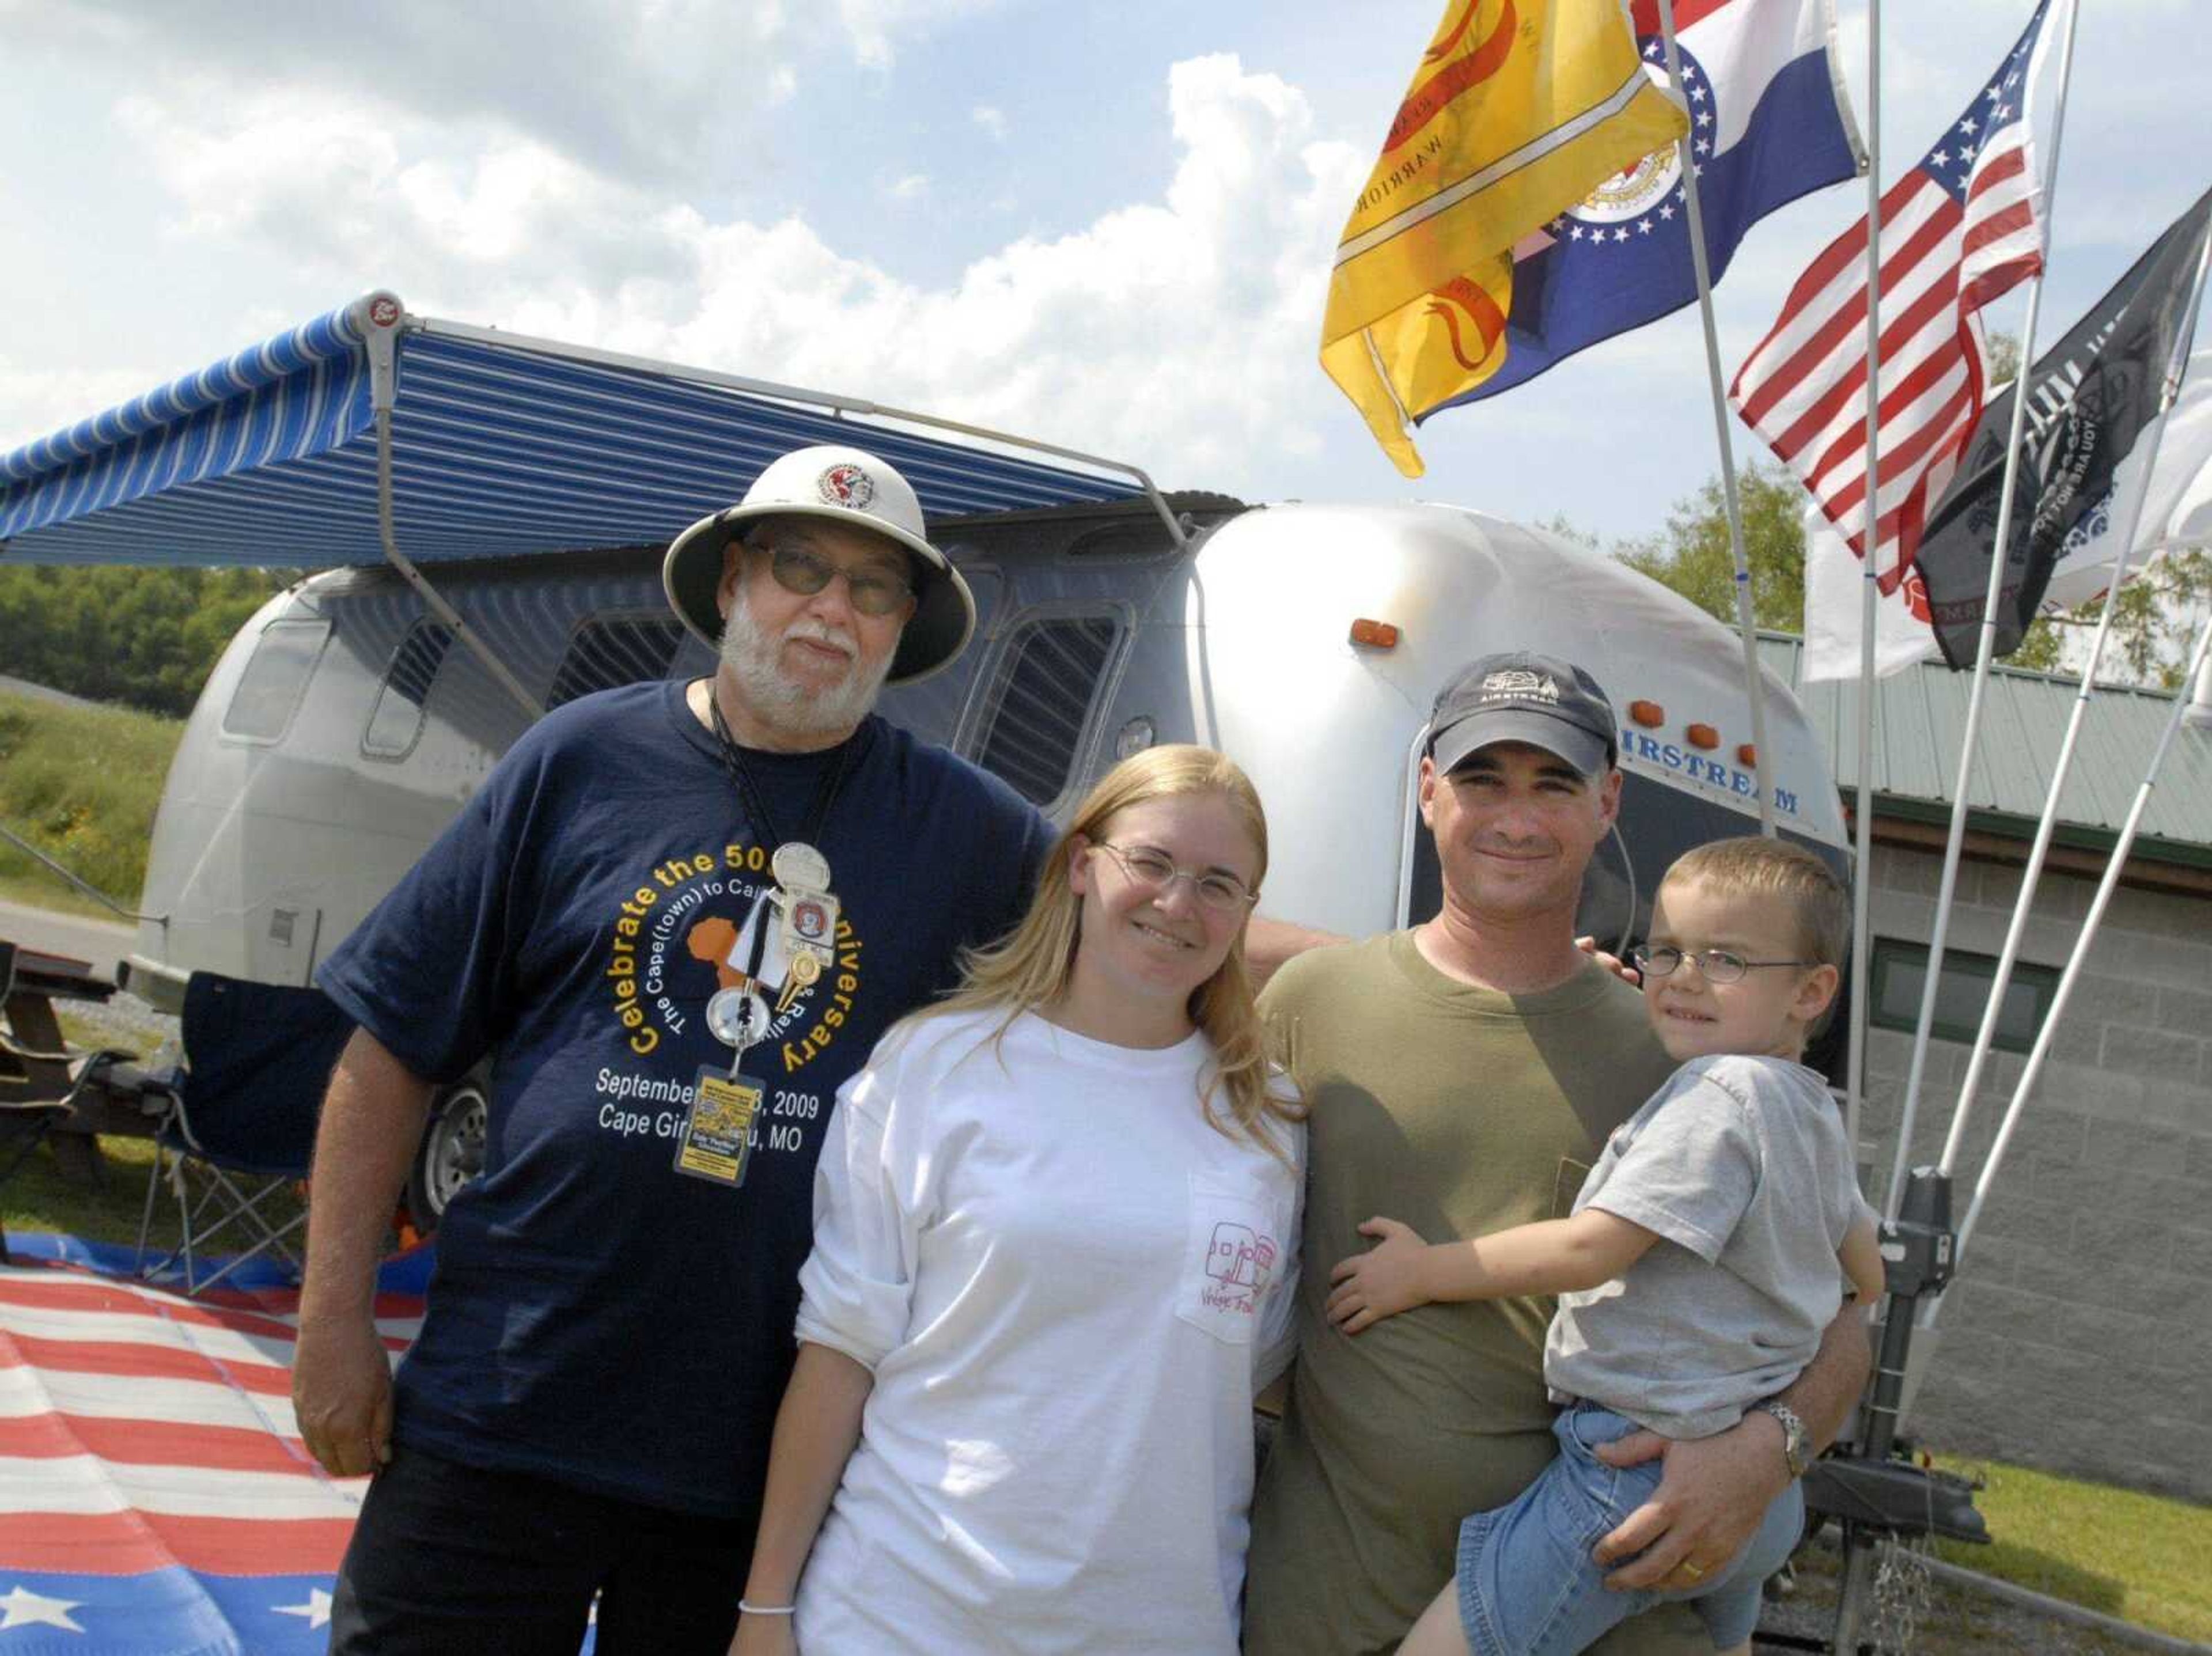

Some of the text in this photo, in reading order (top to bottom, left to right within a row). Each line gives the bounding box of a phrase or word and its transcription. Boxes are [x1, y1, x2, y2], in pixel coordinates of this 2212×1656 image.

[1620, 729, 1798, 814] IRSTREM
[703, 881, 723, 896] to
[608, 843, 863, 1072] Celebrate the 50 niversary
[646, 888, 703, 994] Cape(town)
[657, 997, 687, 1035] The
[599, 1104, 651, 1136] Cape
[770, 1127, 801, 1152] MO
[773, 1090, 819, 1120] 2009
